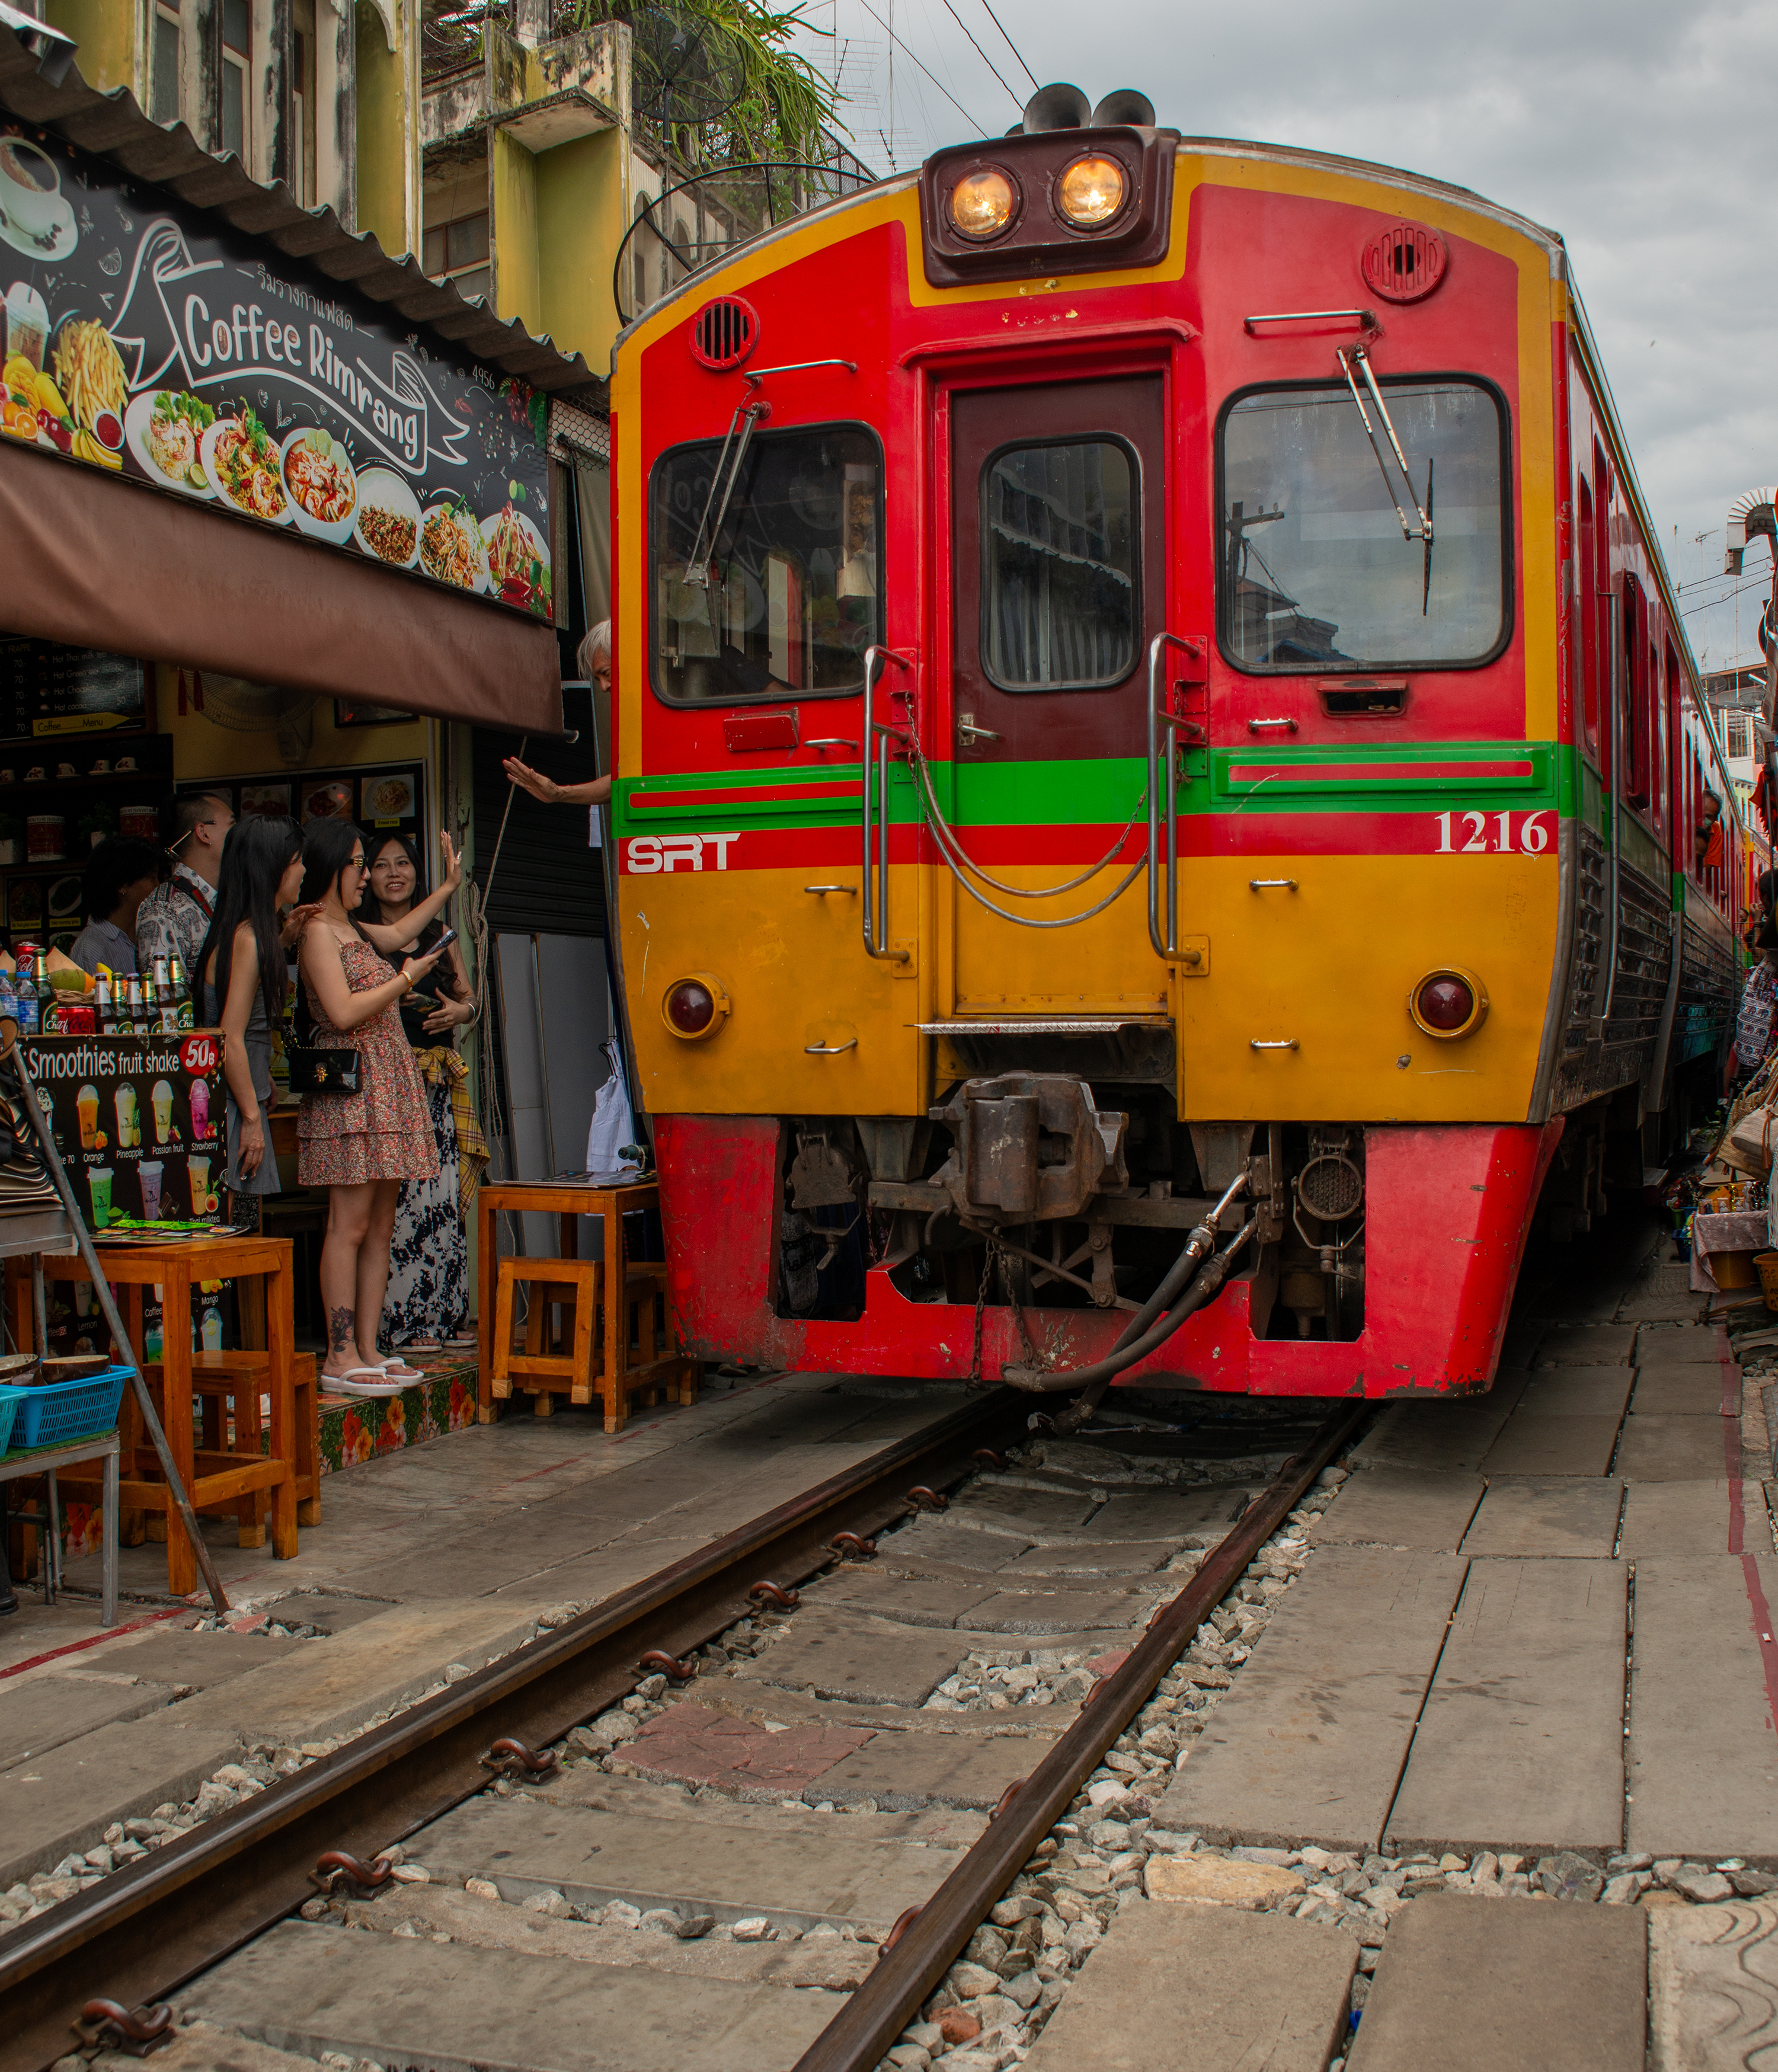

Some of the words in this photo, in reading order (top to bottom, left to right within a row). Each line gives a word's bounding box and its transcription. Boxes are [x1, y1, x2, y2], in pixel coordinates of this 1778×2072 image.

[257, 263, 353, 332] ริมรางกาแฟสด
[184, 294, 302, 367] Coffee
[310, 324, 417, 461] Rimrang
[472, 364, 495, 390] 4956
[8, 643, 31, 654] FRAPPE
[52, 655, 64, 664] Hot
[66, 653, 79, 662] Thai
[53, 671, 65, 680] Hot
[66, 670, 87, 679] Green
[54, 688, 65, 696] Hot
[54, 704, 66, 712] Hot
[38, 720, 62, 732] Coffee
[82, 718, 103, 727] Menu
[1434, 810, 1548, 852] 1216
[628, 832, 741, 874] SRT
[28, 1044, 116, 1080] Smoothies
[119, 1050, 144, 1076] fruit
[146, 1049, 180, 1074] shake
[152, 1145, 172, 1155] Passion
[172, 1143, 185, 1153] fruit
[191, 1141, 219, 1152] Strawberry
[67, 1154, 75, 1164] 70
[83, 1153, 104, 1164] Orange
[116, 1148, 144, 1160] Pineapple
[201, 1295, 219, 1306] Mango
[145, 1306, 163, 1318] Coffee
[78, 1320, 98, 1332] Lemon
